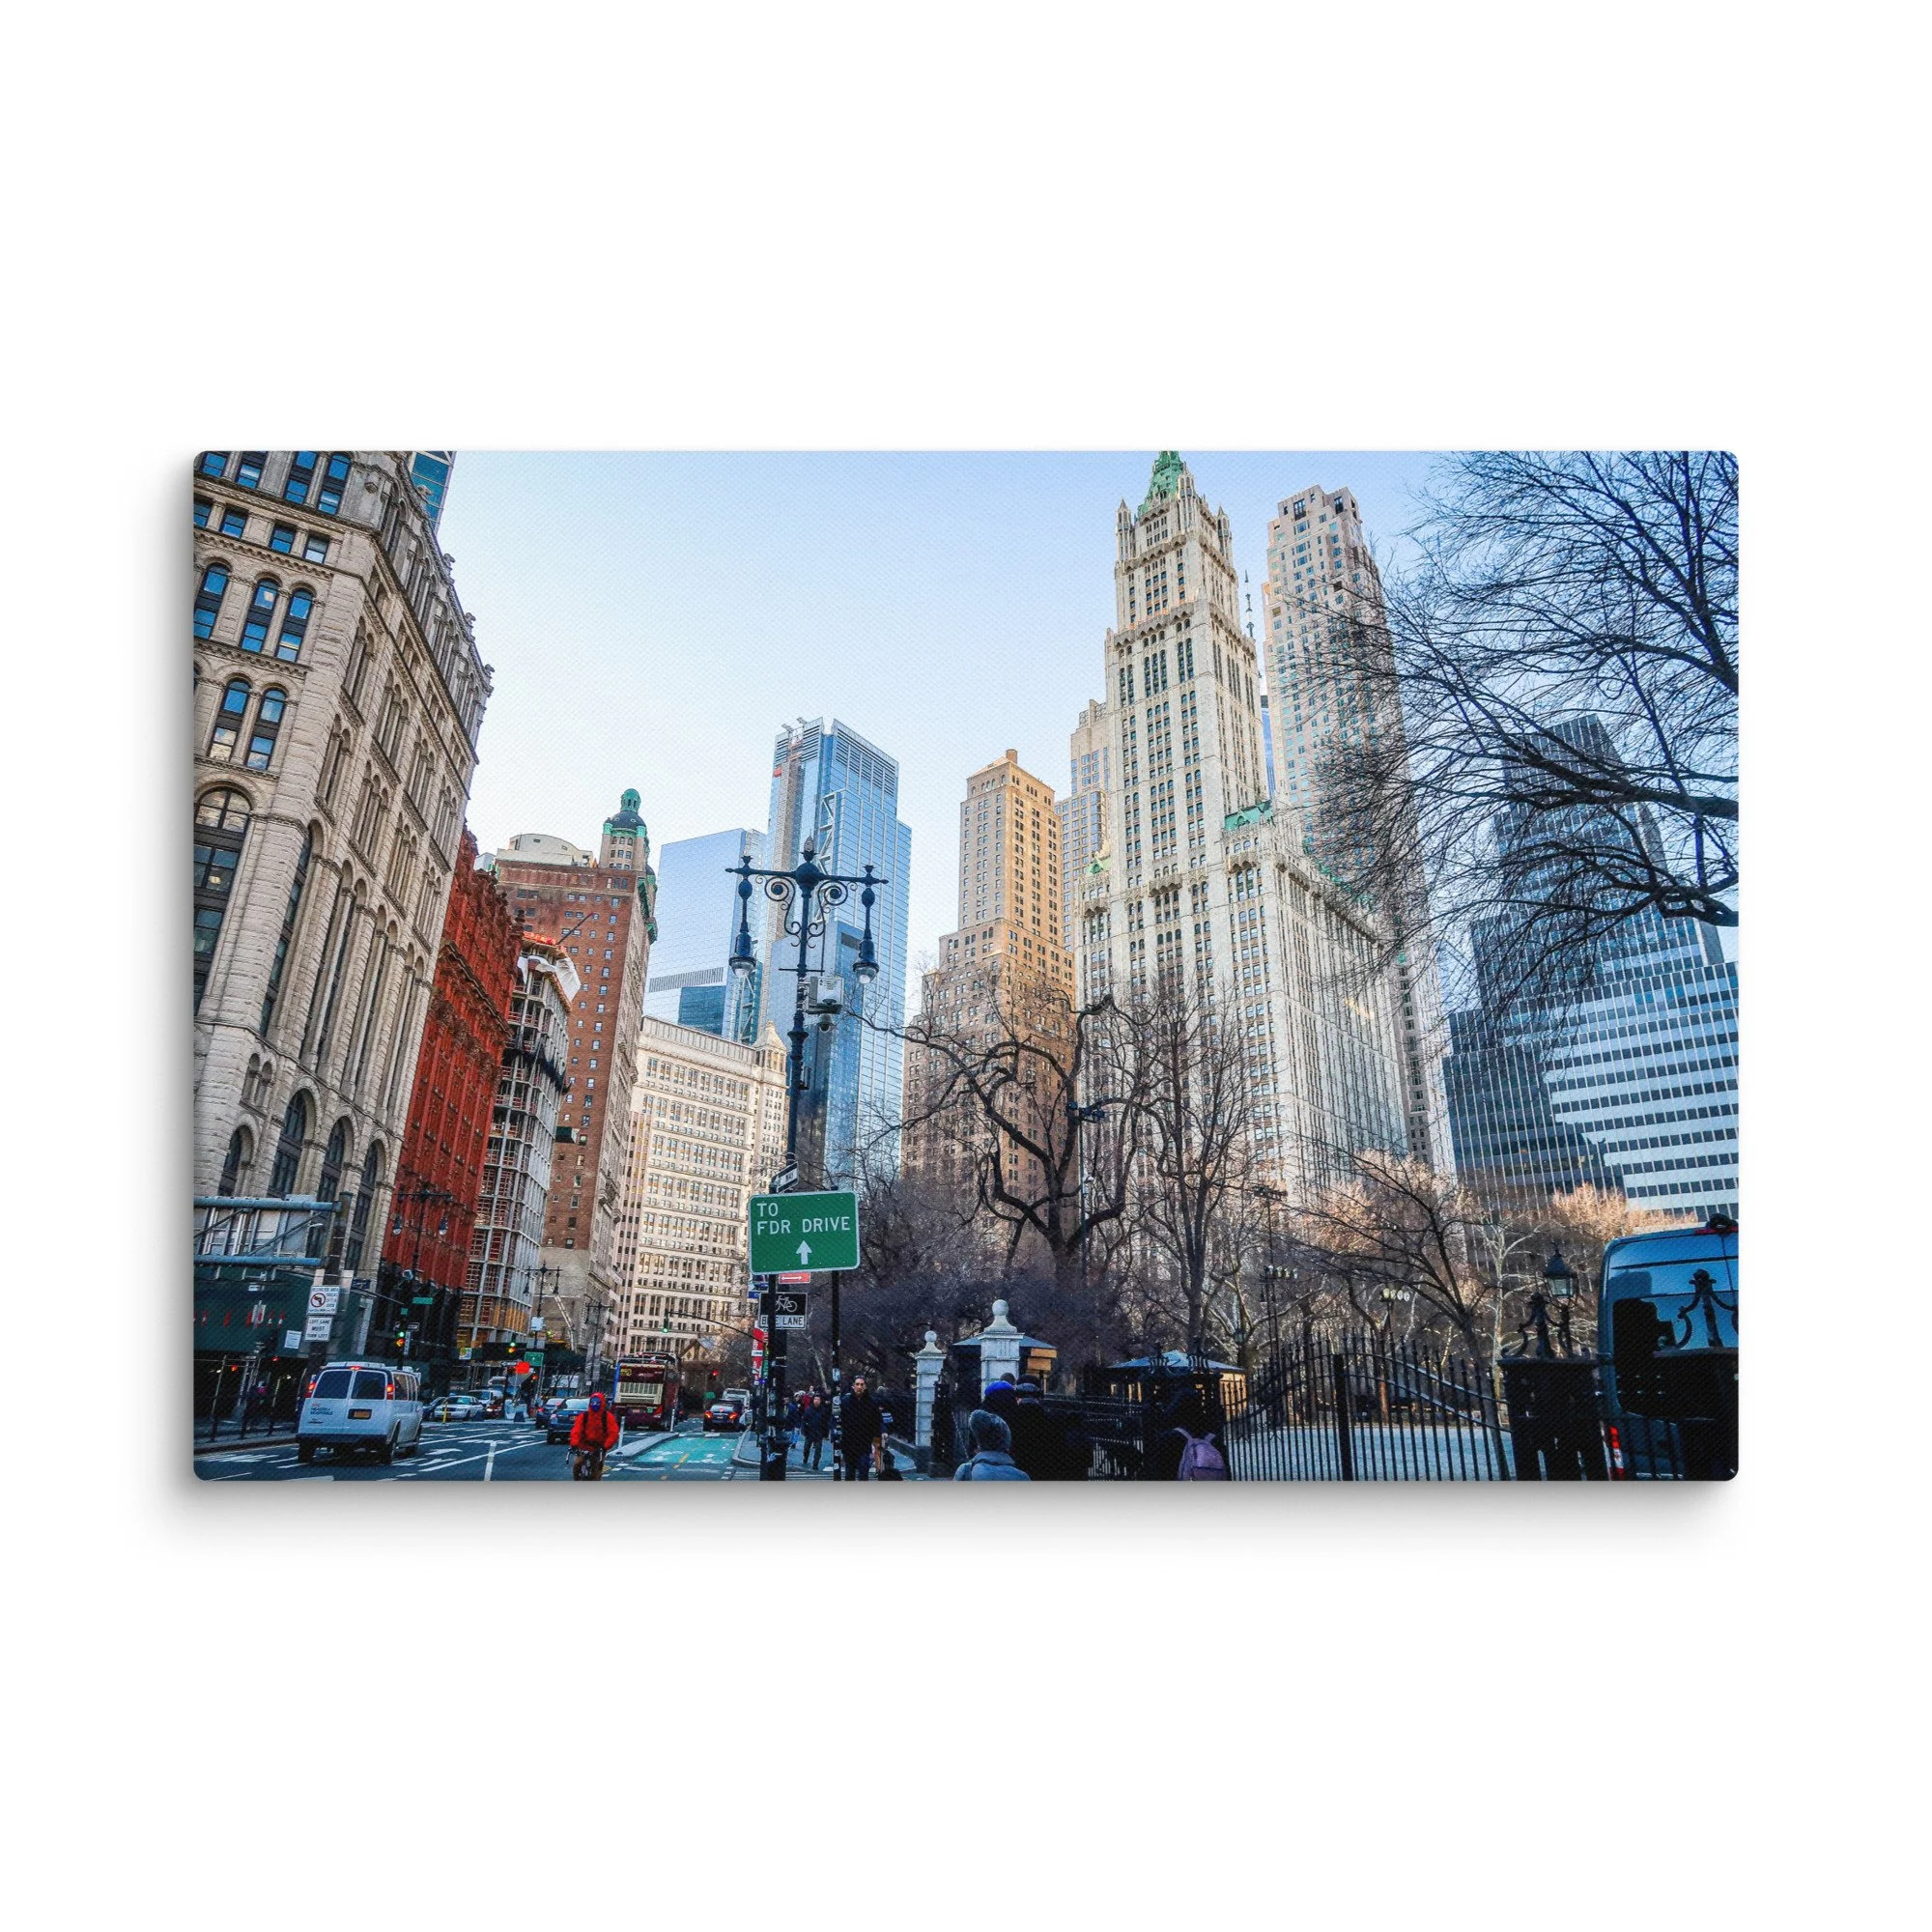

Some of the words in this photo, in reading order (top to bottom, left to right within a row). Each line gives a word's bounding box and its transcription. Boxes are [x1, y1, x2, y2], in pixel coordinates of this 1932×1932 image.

[756, 1202, 779, 1217] TO
[756, 1219, 791, 1236] FDR
[802, 1216, 851, 1234] DRIVE
[761, 1316, 780, 1325] BE
[782, 1316, 804, 1325] LANE
